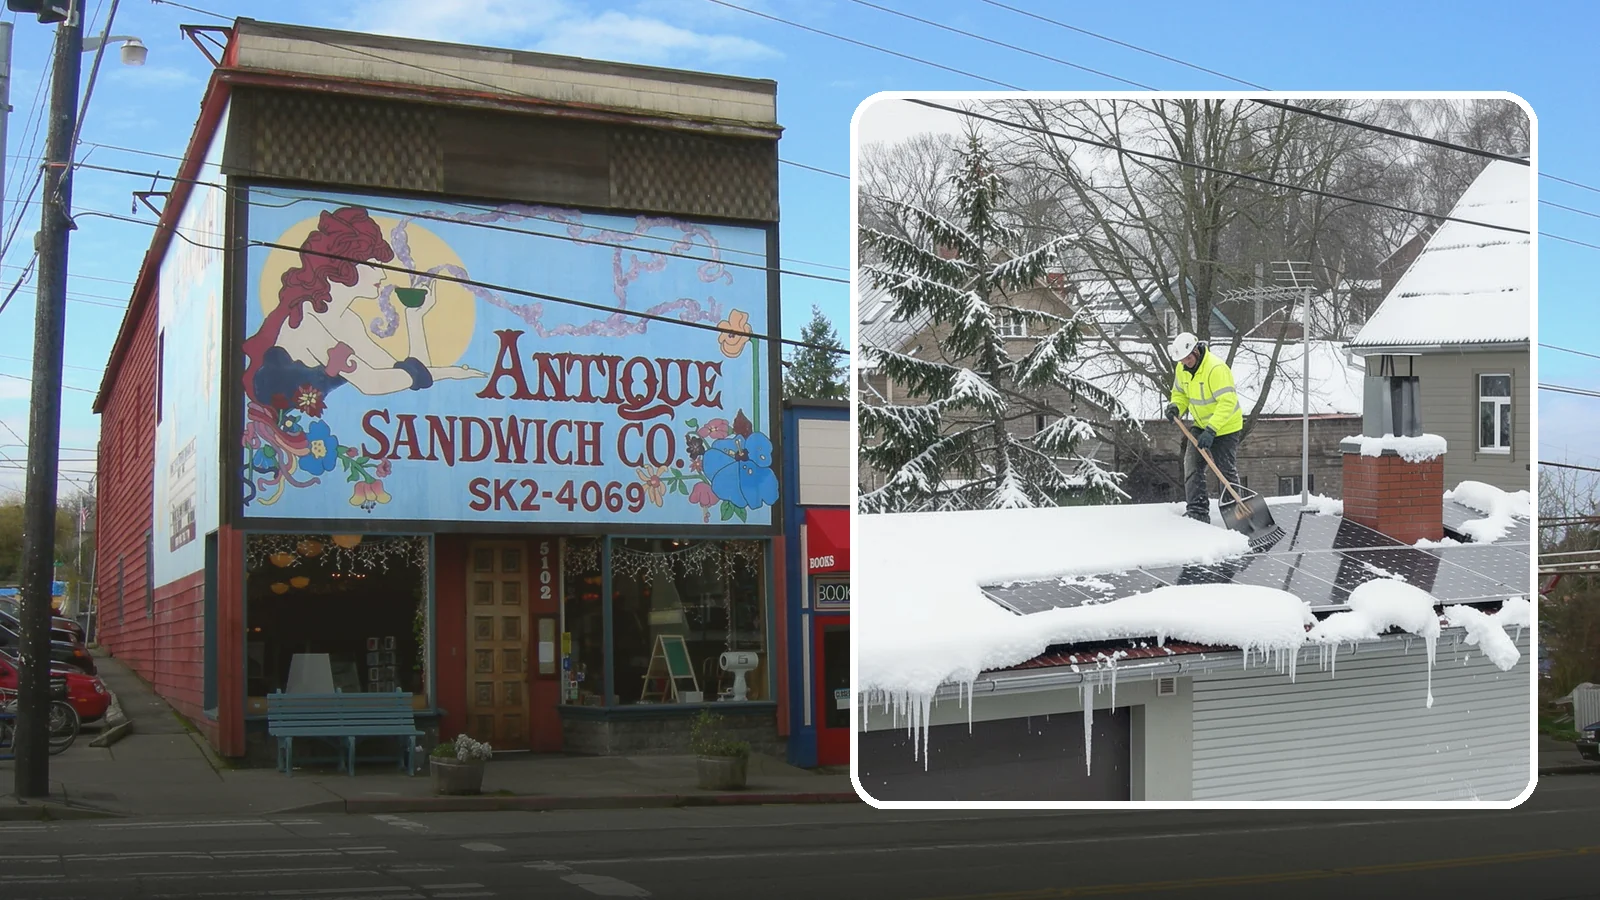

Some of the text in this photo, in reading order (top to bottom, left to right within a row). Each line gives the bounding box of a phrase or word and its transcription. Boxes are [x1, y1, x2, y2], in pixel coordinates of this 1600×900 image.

[475, 329, 723, 421] ANTIQUE
[361, 409, 685, 469] SANDWICH CO.
[469, 477, 645, 513] SK2-4069
[539, 541, 552, 600] 5102
[809, 555, 835, 569] BOOKS
